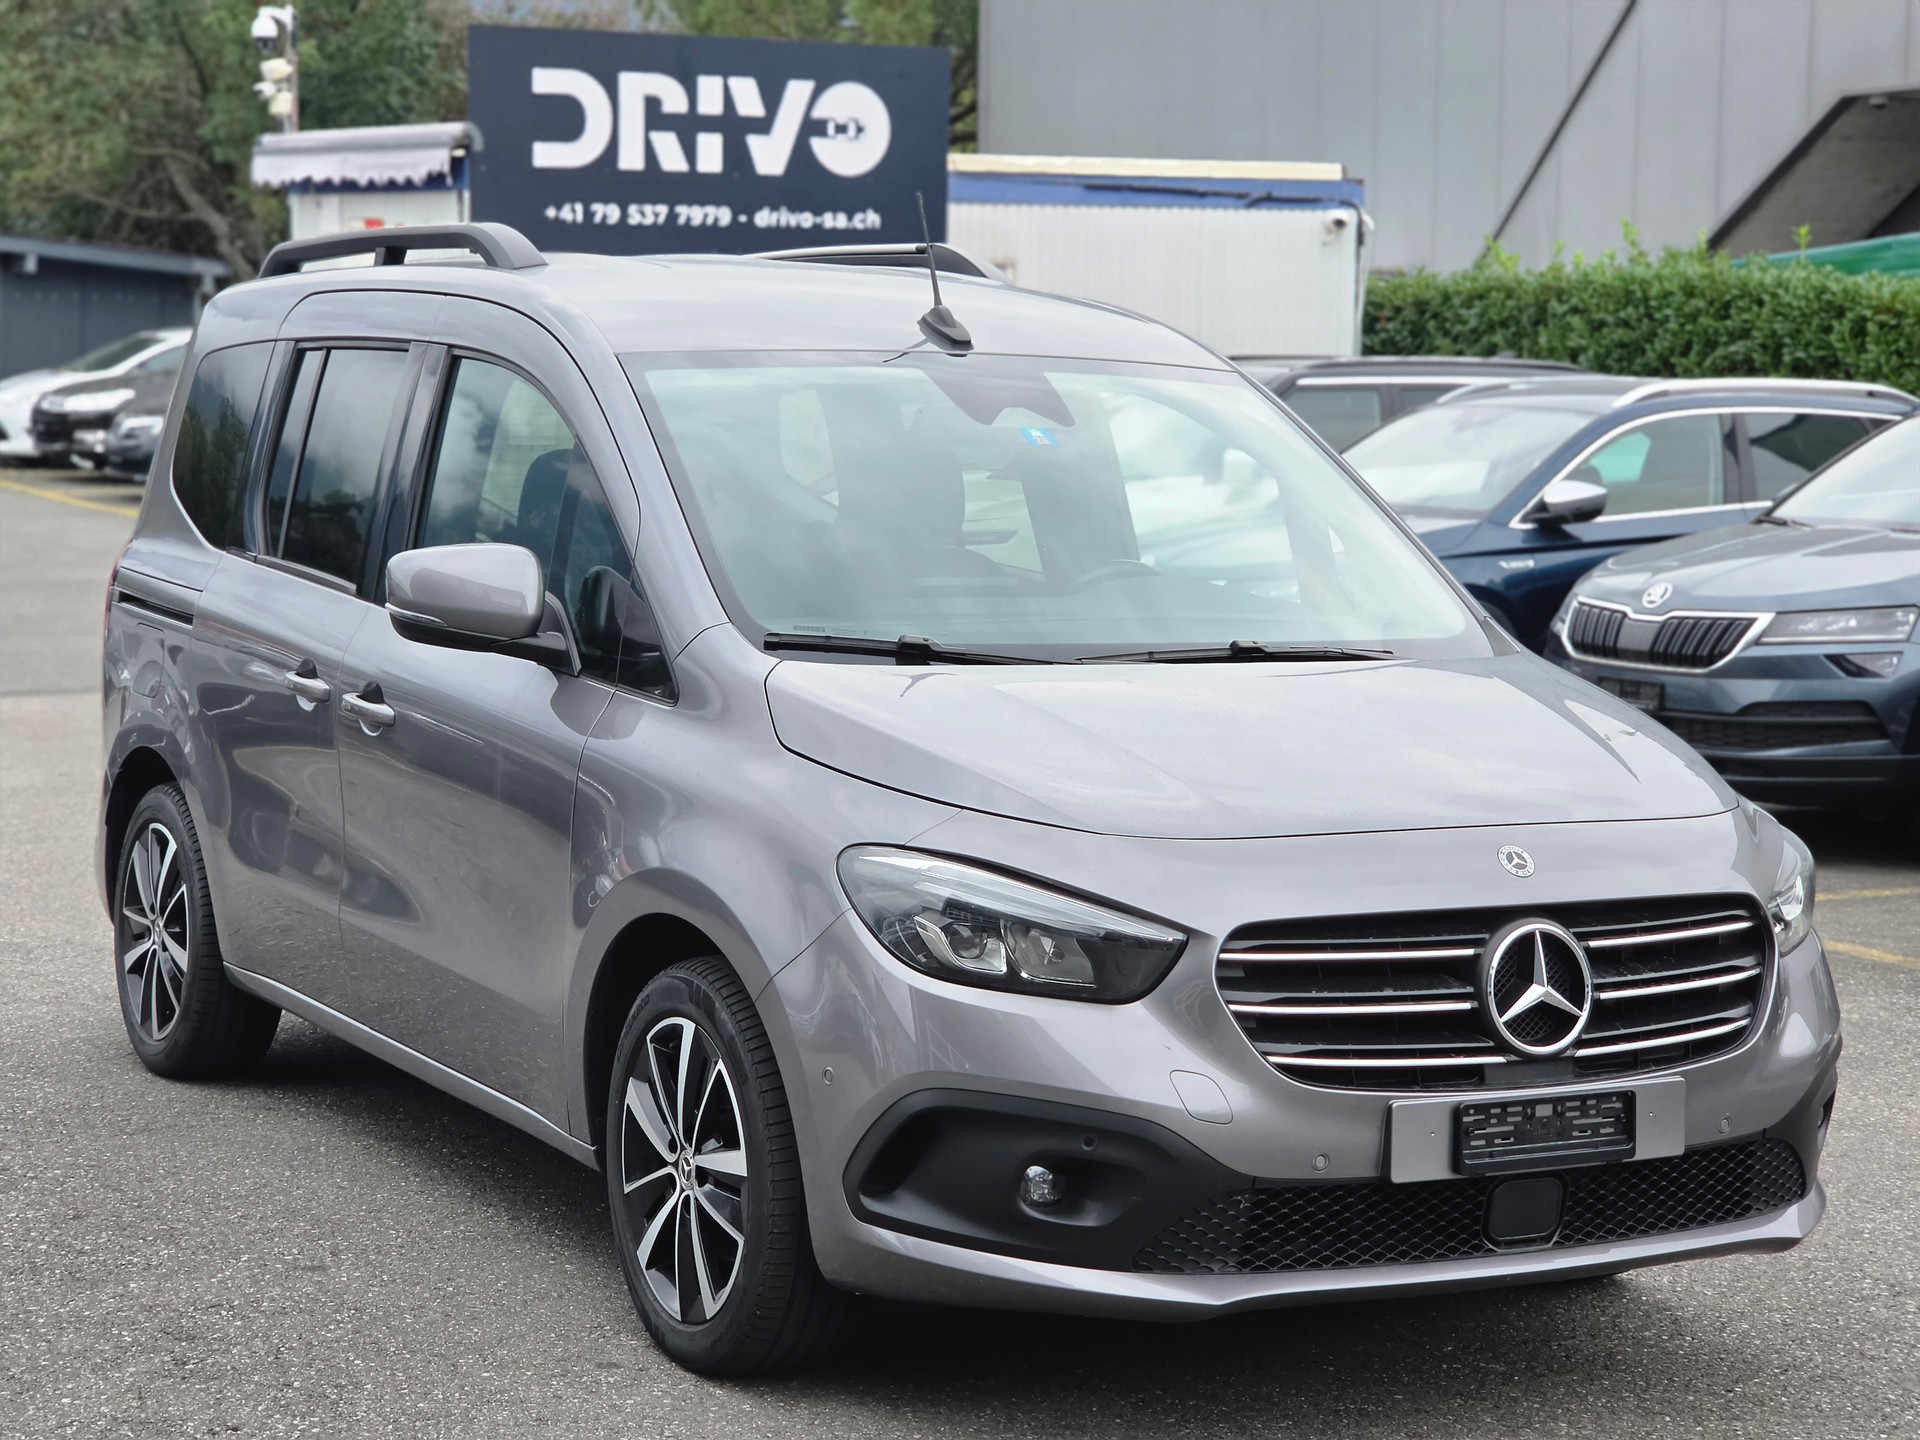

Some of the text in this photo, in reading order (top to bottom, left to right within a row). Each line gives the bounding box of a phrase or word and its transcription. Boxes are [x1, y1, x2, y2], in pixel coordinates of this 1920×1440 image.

[531, 66, 892, 178] DRIVO
[544, 202, 584, 224] +41
[590, 202, 621, 225] 79
[627, 203, 669, 226] 537
[674, 204, 732, 227] 7979
[753, 206, 881, 230] drivo-sa.ch
